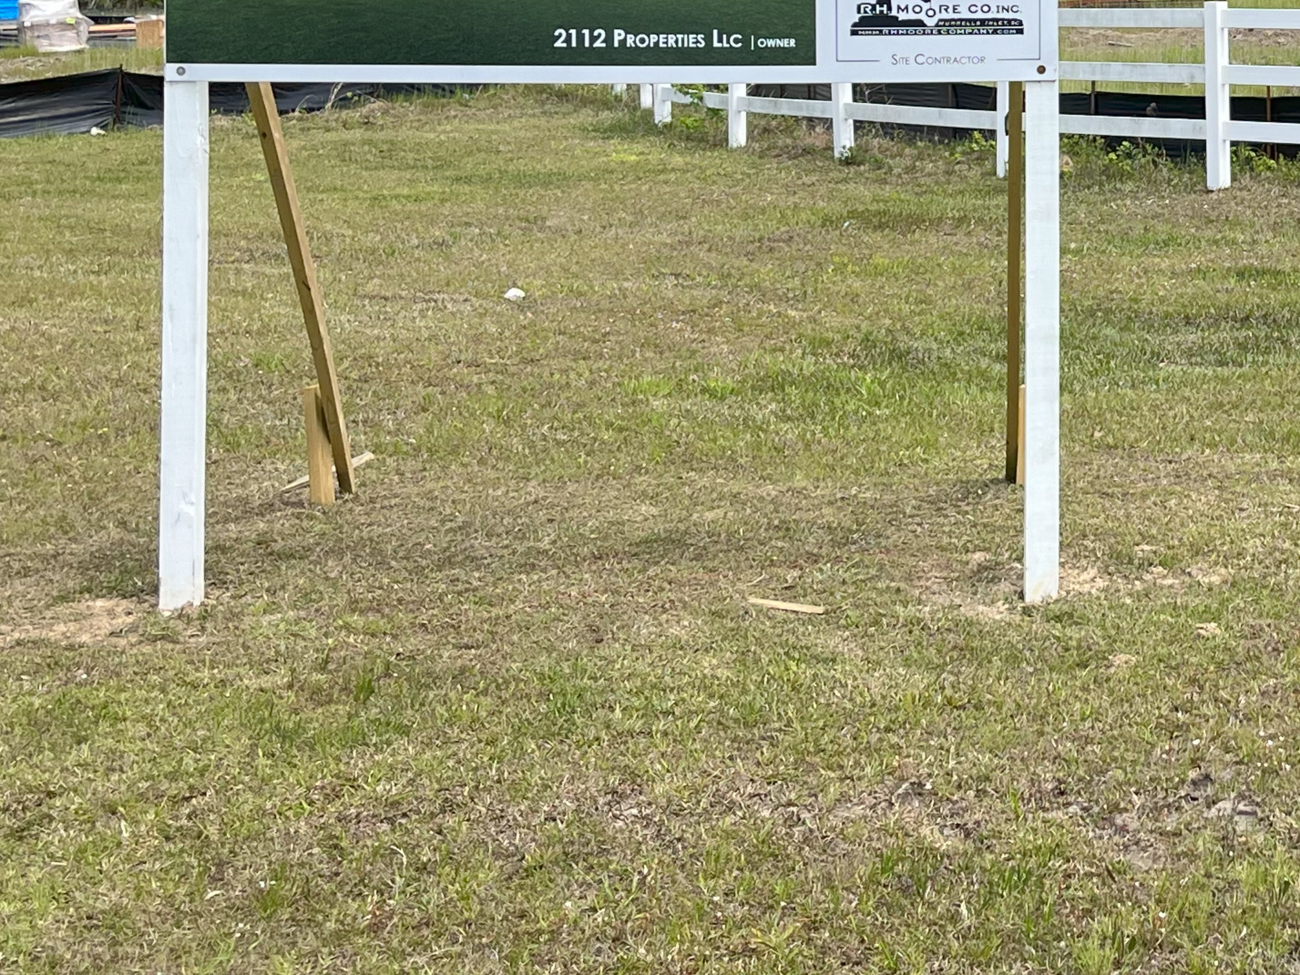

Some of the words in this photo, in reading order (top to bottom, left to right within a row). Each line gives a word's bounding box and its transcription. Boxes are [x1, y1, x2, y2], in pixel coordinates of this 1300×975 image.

[896, 4, 961, 18] MOORE
[553, 28, 607, 48] 2112
[613, 28, 706, 48] PROPERTIES
[890, 53, 911, 66] SITE
[914, 53, 987, 66] CONTRACTOR
